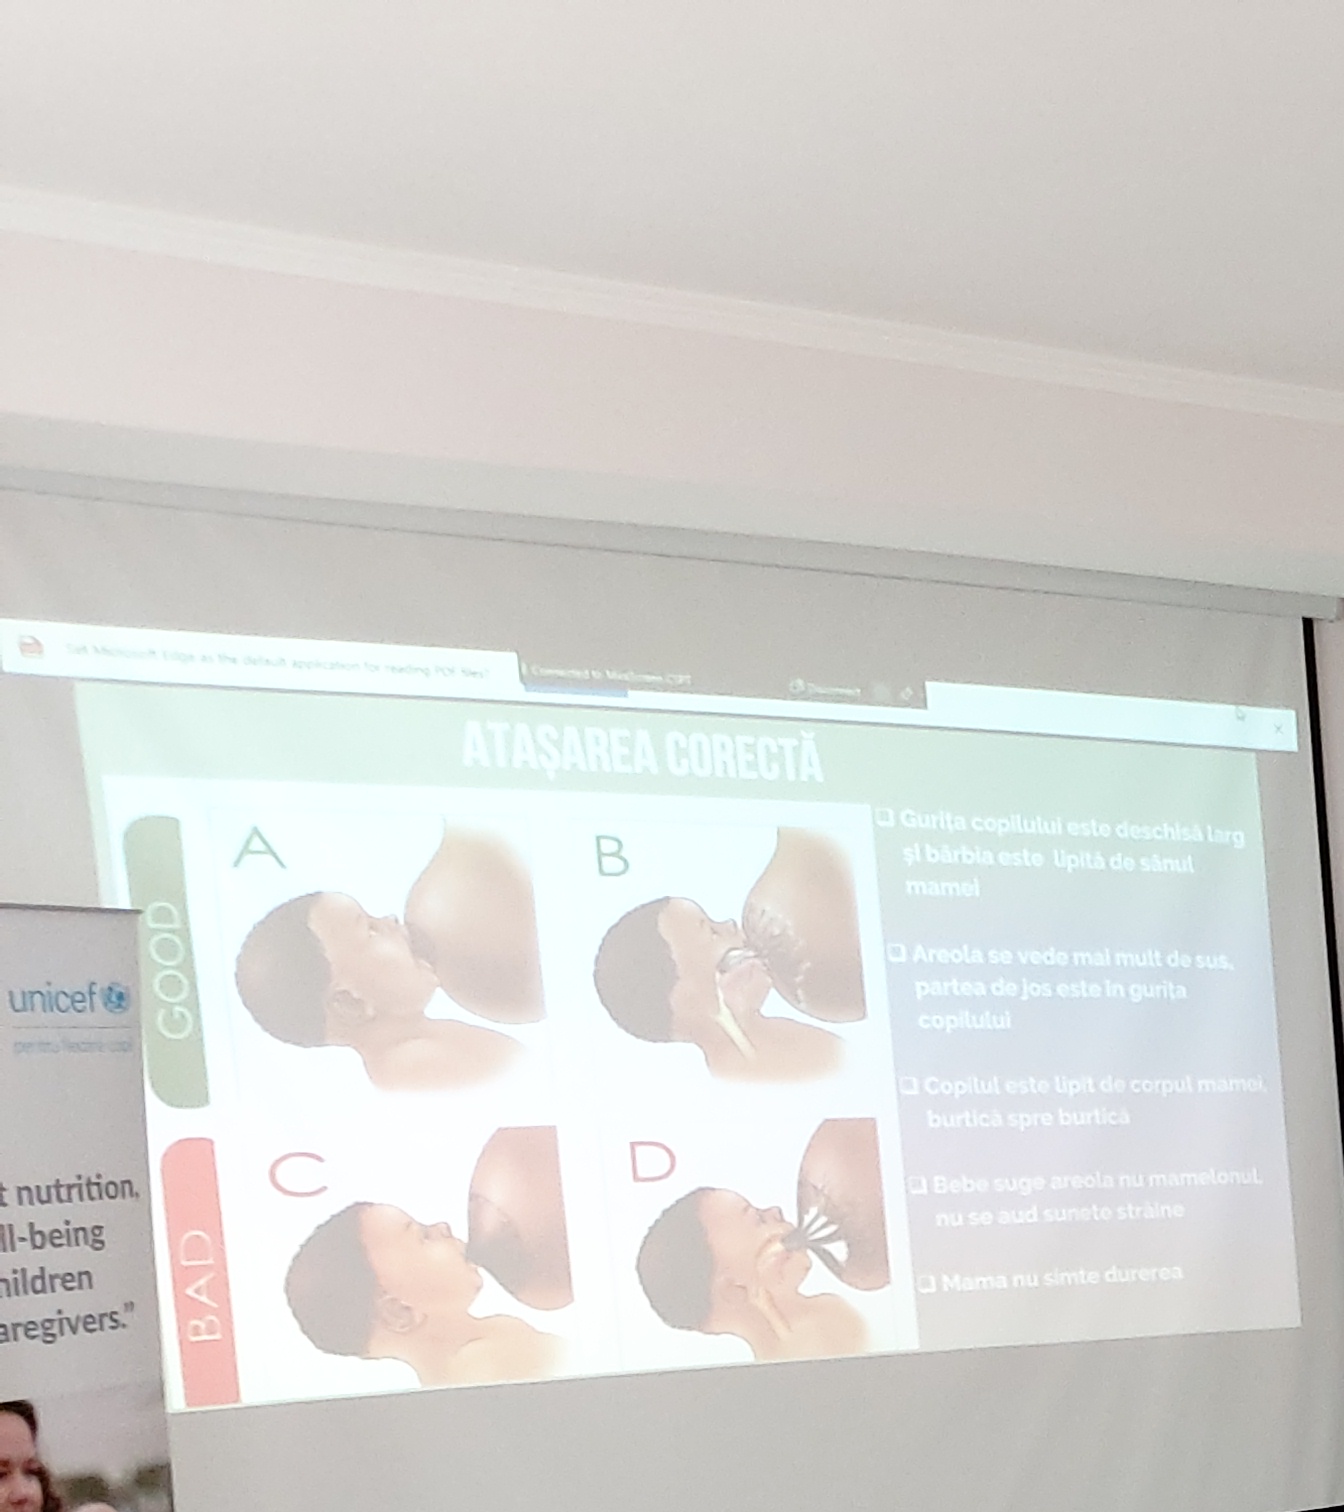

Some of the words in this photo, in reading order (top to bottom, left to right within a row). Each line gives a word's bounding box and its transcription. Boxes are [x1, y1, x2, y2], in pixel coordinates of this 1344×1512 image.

[666, 729, 825, 784] CORECTĂ
[971, 812, 1062, 839] copilului
[1067, 819, 1111, 839] este
[1207, 825, 1246, 849] larg
[232, 826, 287, 869] A
[595, 835, 630, 877] B
[998, 848, 1044, 868] este
[1110, 850, 1135, 872] de
[905, 877, 980, 898] mamei
[145, 902, 194, 1040] GOOD
[912, 944, 984, 965] Areola
[988, 949, 1013, 965] se
[1018, 946, 1069, 966] vede
[1073, 948, 1110, 966] mai
[1115, 948, 1163, 968] mult
[1167, 949, 1192, 969] de
[8, 981, 97, 1013] unicef
[915, 977, 985, 1001] partea
[990, 977, 1018, 998] de
[1021, 976, 1052, 1001] jos
[1057, 980, 1101, 999] este
[918, 1011, 1012, 1033] copilului
[924, 1077, 1000, 1099] Copilul
[1004, 1078, 1050, 1096] este
[1054, 1076, 1095, 1098] lipit
[1099, 1075, 1127, 1095] de
[1129, 1074, 1193, 1097] corpul
[1008, 1109, 1054, 1131] spre
[268, 1151, 329, 1198] C
[628, 1140, 677, 1183] D
[933, 1174, 989, 1194] Bebe
[994, 1175, 1046, 1197] suge
[1050, 1170, 1115, 1191] areola
[1119, 1172, 1145, 1189] nu
[936, 1209, 964, 1227] nu
[968, 1209, 993, 1226] se
[997, 1203, 1039, 1225] aud
[1043, 1204, 1113, 1224] sunete
[179, 1230, 222, 1342] BAD
[942, 1271, 1008, 1293] Mama
[1012, 1271, 1039, 1289] nu
[1043, 1266, 1100, 1287] simte
[1104, 1264, 1184, 1285] durerea
